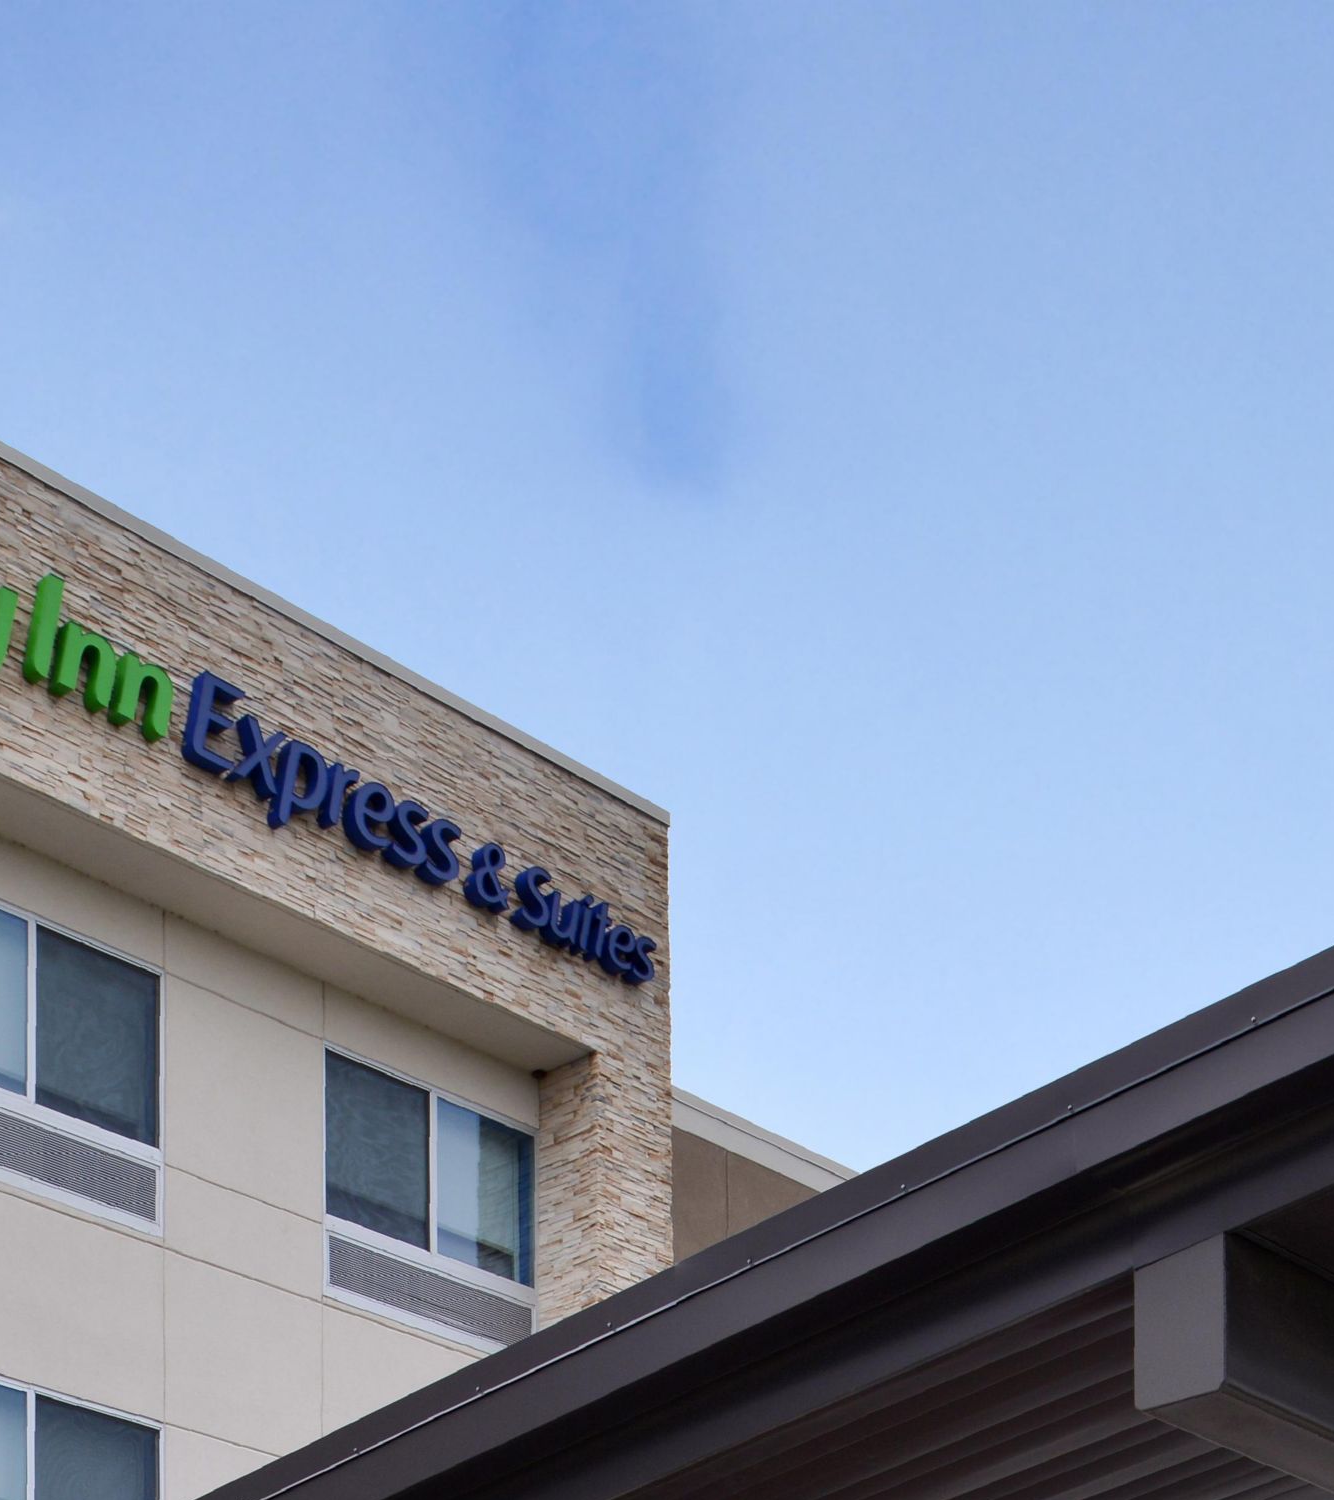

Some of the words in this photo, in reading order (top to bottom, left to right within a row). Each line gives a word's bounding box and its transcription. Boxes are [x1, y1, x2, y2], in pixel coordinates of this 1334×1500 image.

[22, 573, 175, 743] Inn
[181, 670, 462, 886] Express
[463, 842, 509, 913] &
[510, 865, 658, 985] Suites
